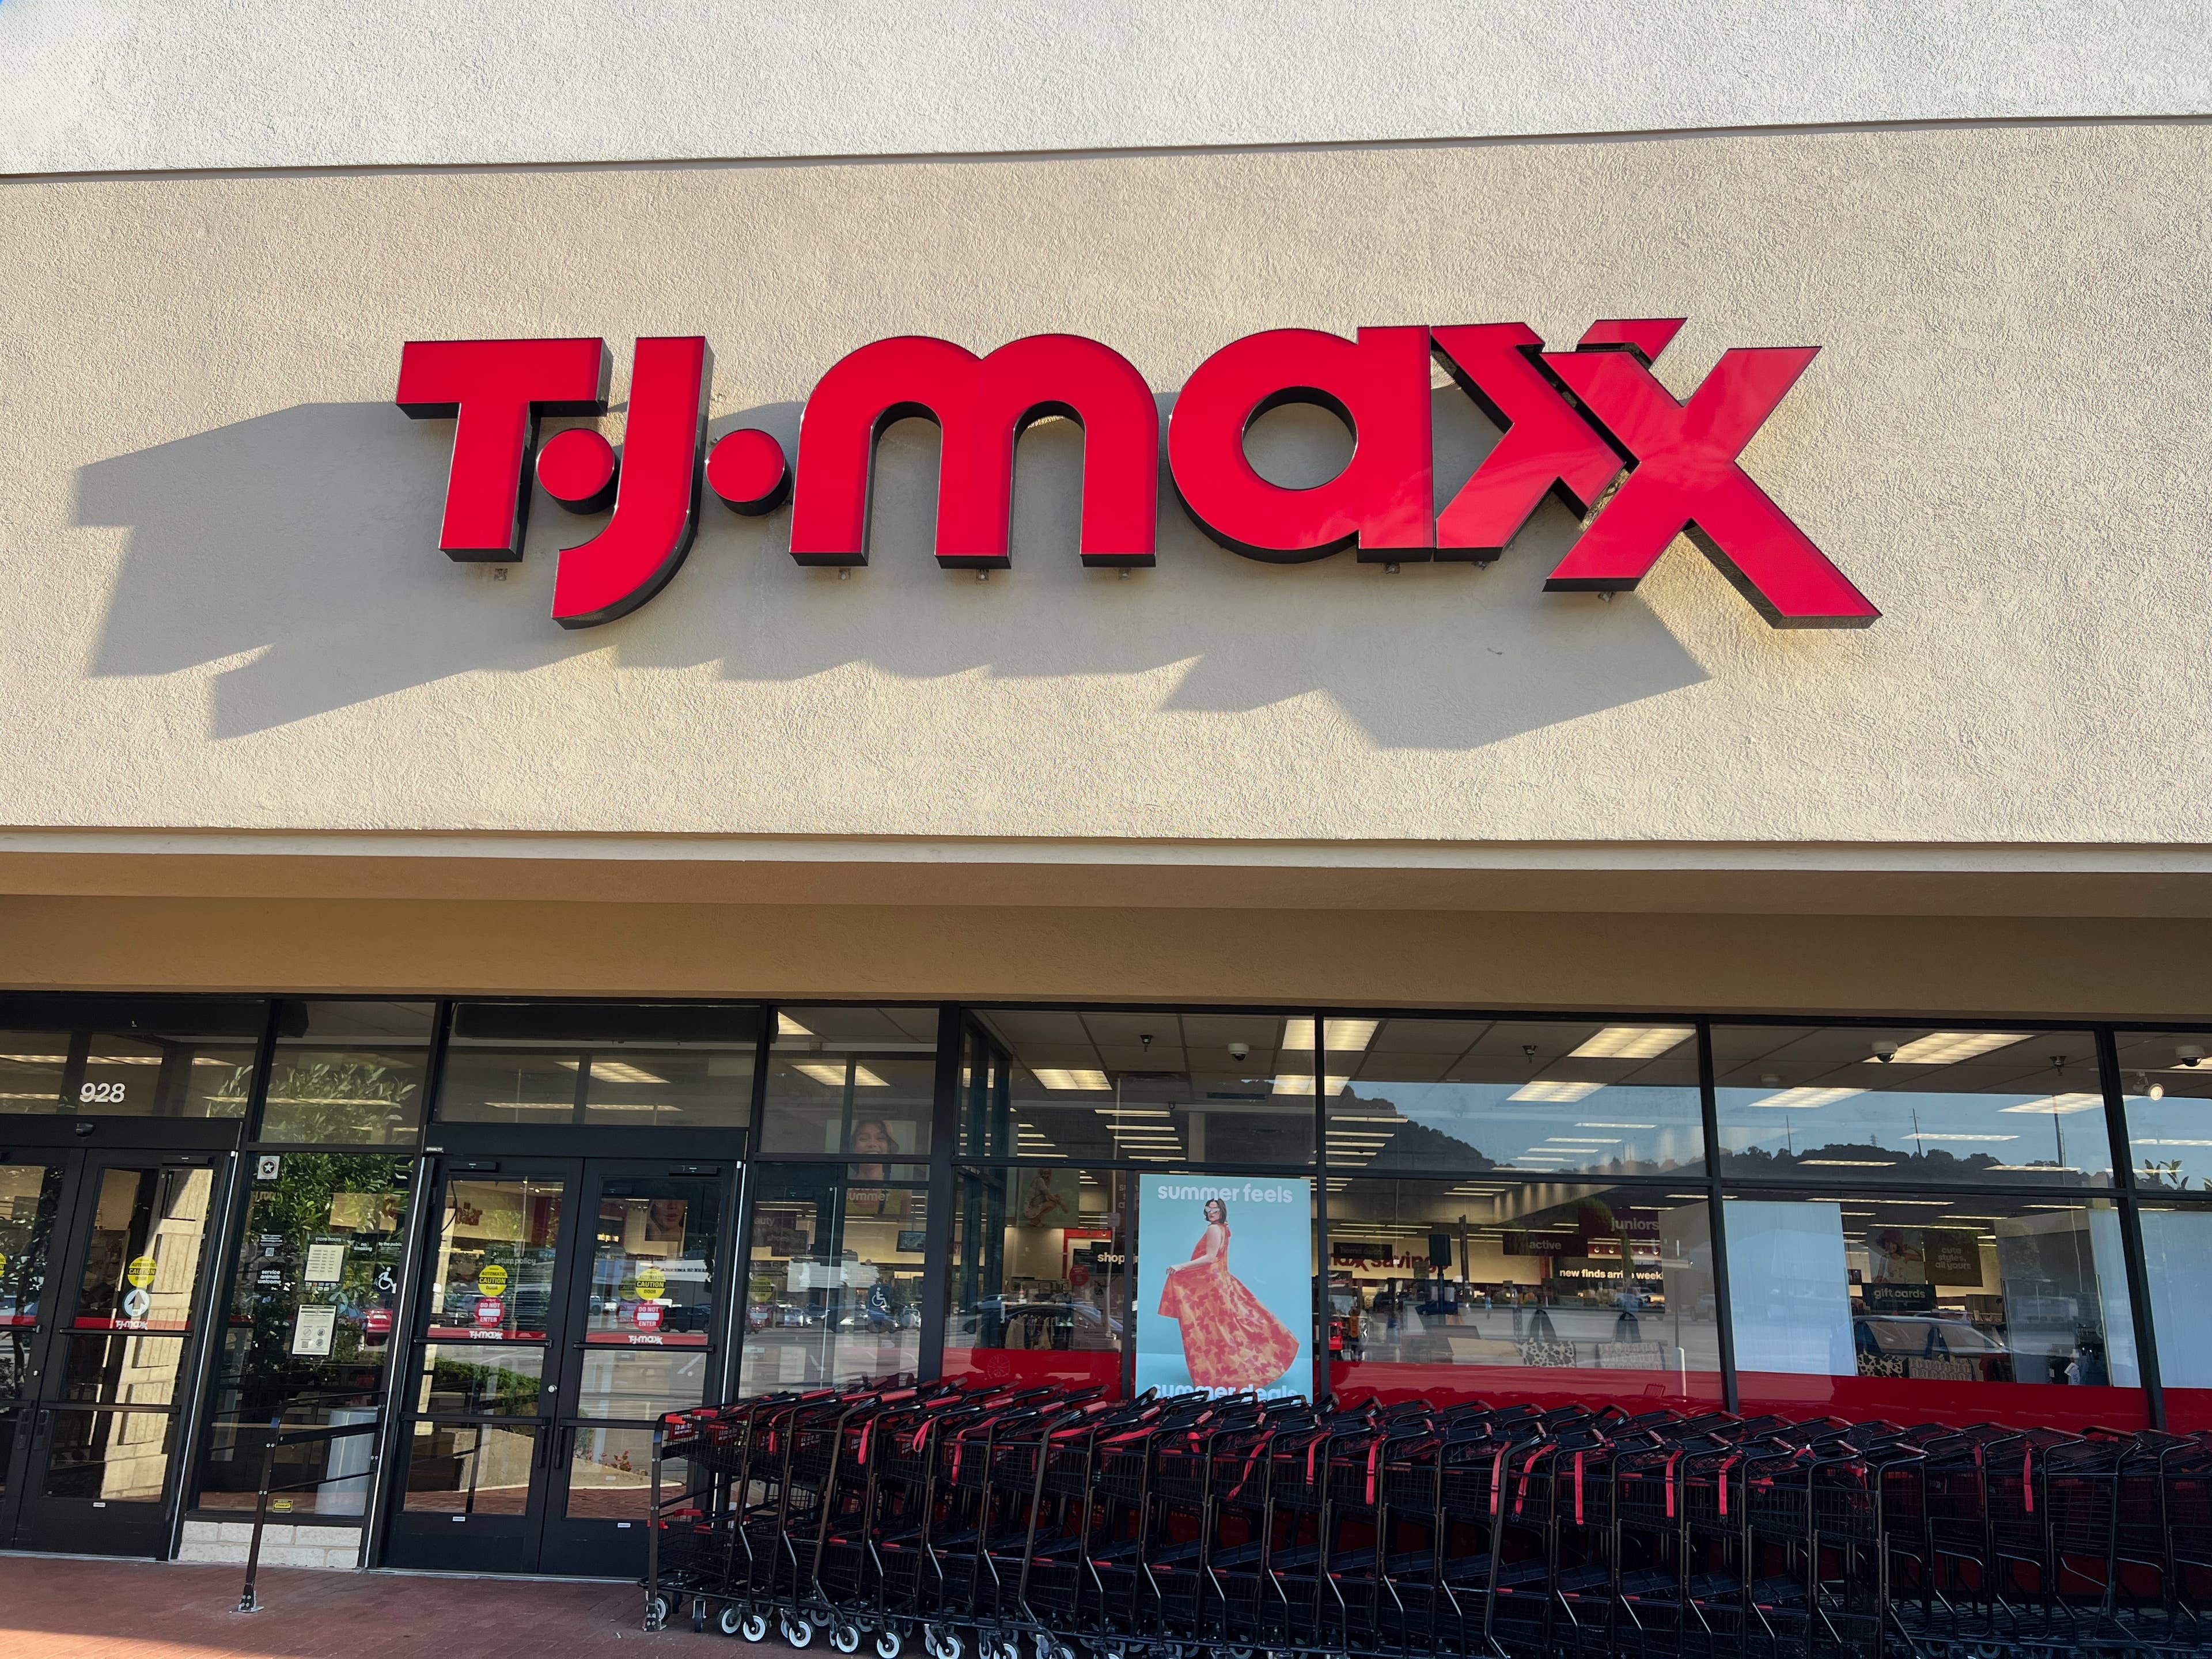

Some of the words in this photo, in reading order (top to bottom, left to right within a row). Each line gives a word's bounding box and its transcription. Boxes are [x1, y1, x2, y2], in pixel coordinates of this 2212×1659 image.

[79, 1083, 126, 1103] 928
[1158, 1185, 1240, 1202] summer
[1243, 1183, 1293, 1203] feels
[1611, 1217, 1659, 1231] juniors
[1529, 1240, 1562, 1250] active
[514, 1257, 536, 1266] policy
[1947, 1263, 1972, 1271] yours
[1582, 1269, 1605, 1278] finds
[1873, 1287, 1893, 1300] gift
[1895, 1289, 1926, 1298] cards
